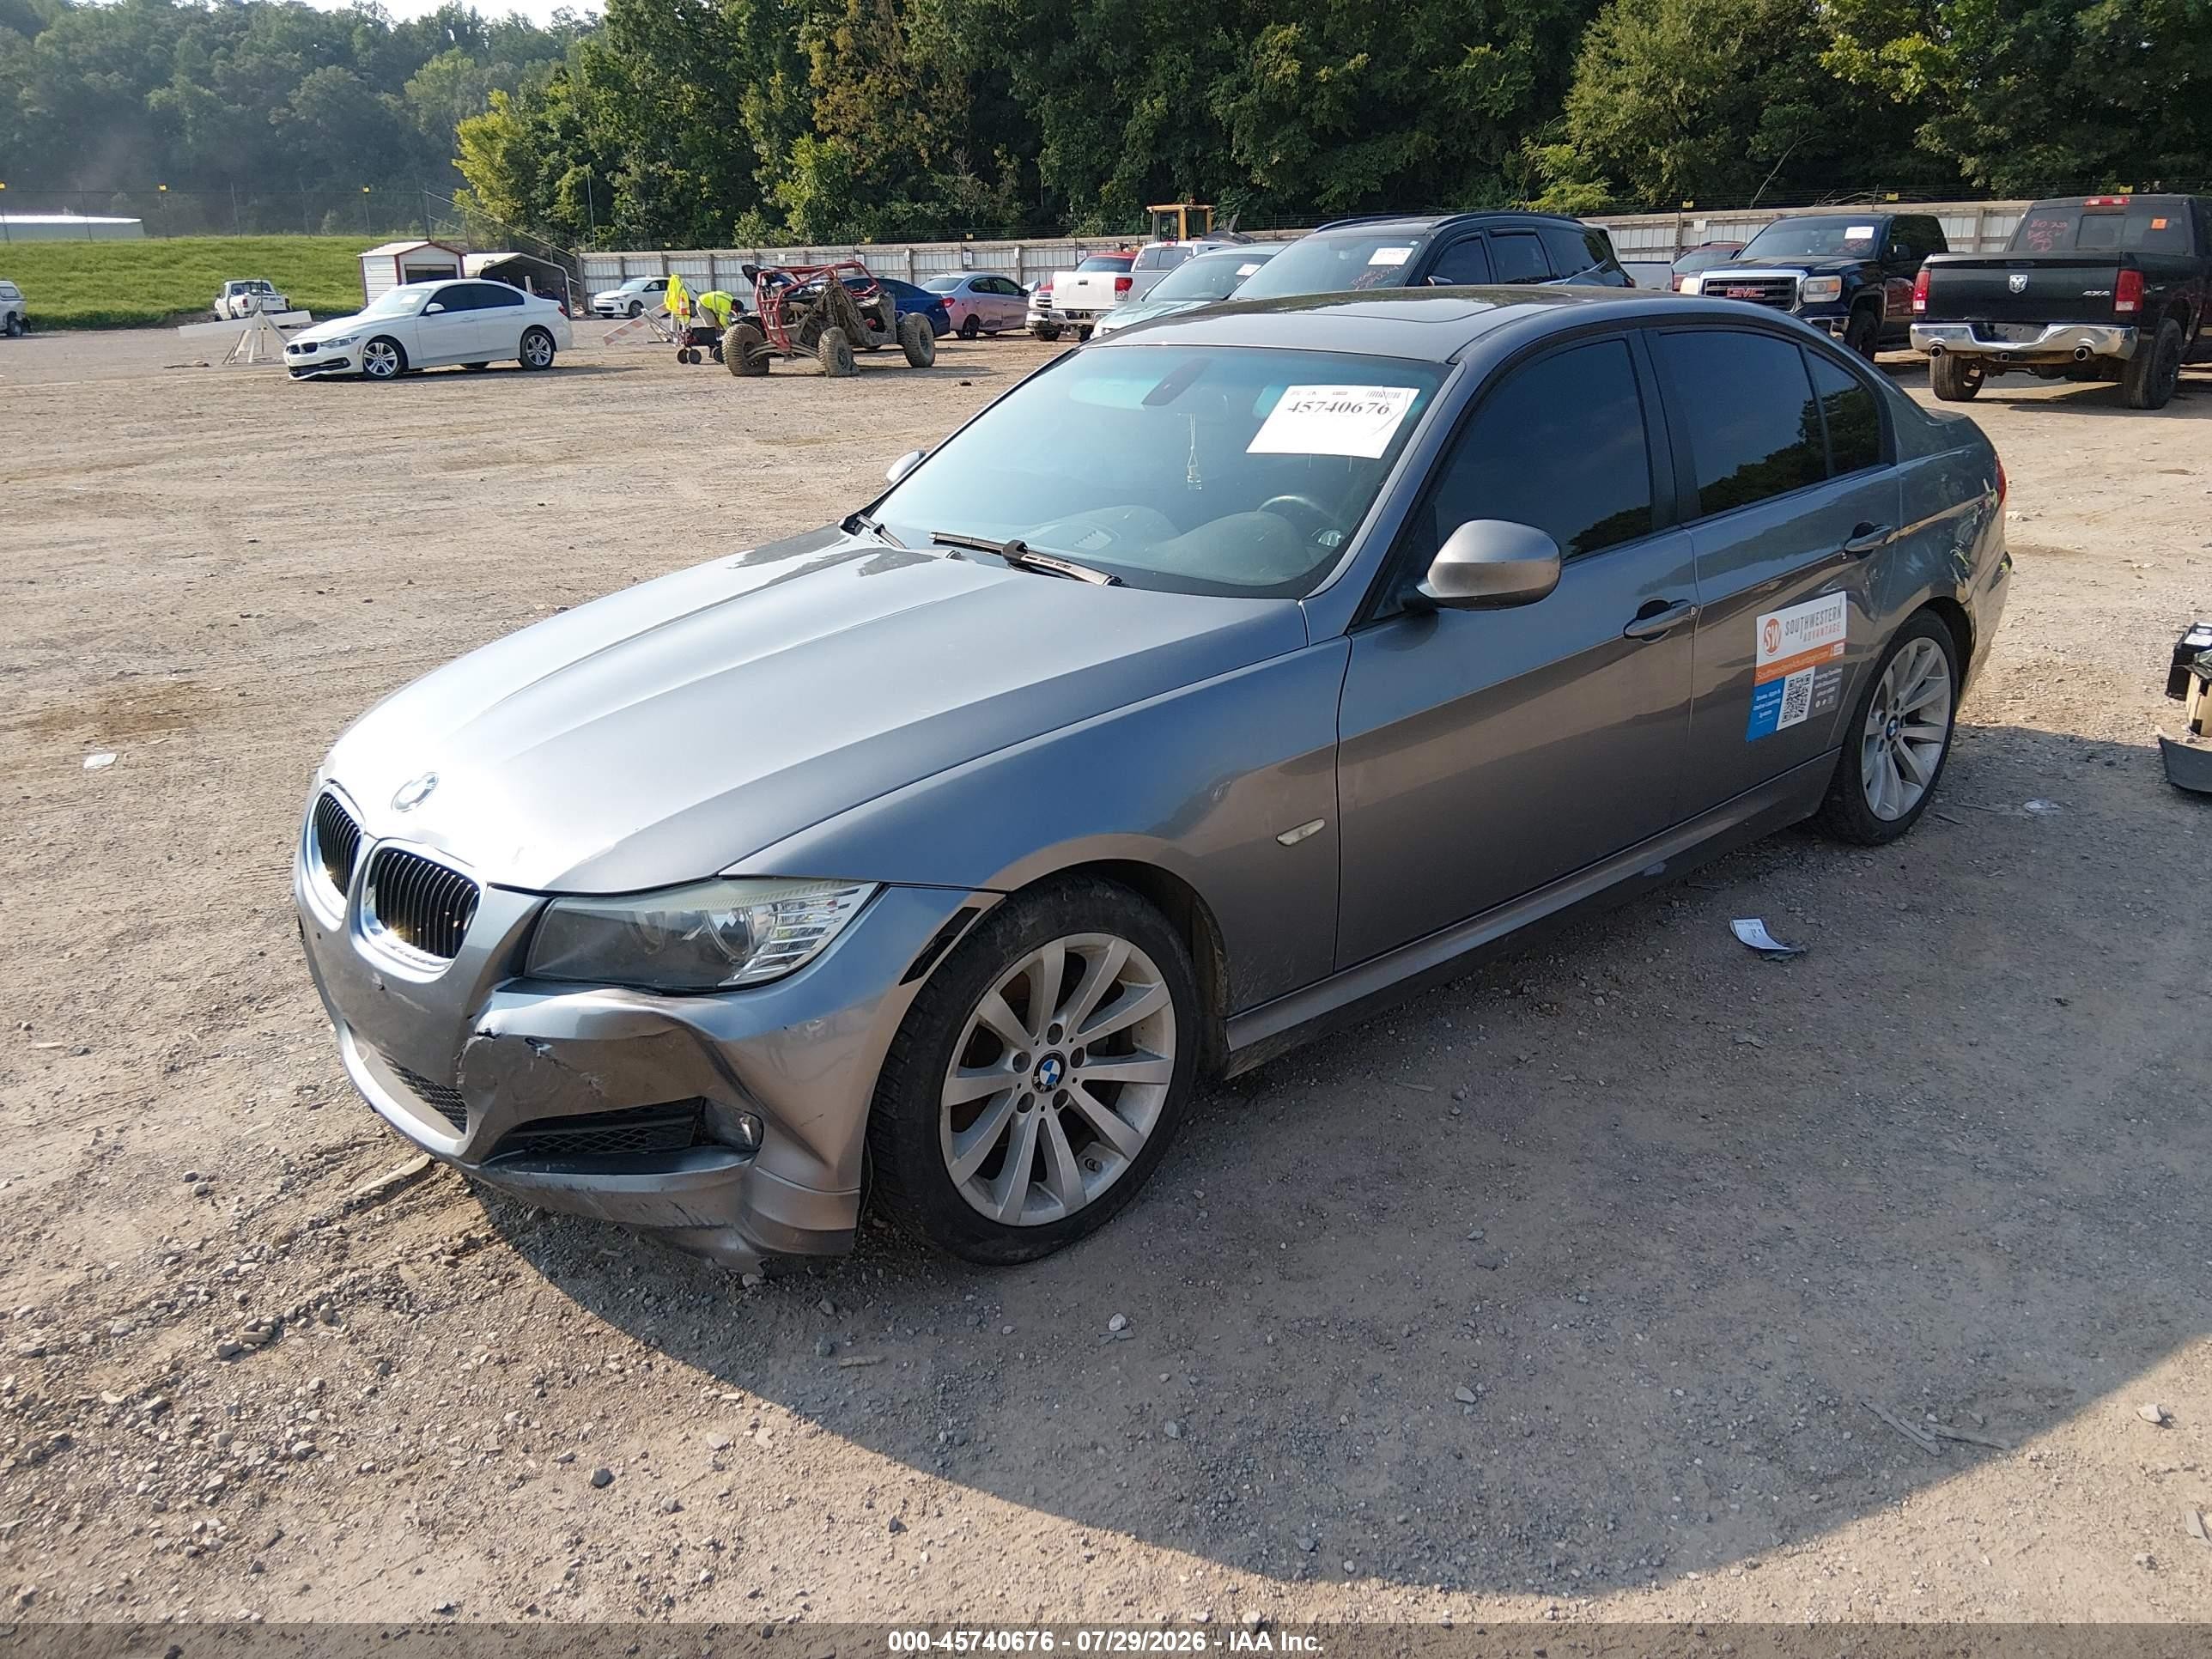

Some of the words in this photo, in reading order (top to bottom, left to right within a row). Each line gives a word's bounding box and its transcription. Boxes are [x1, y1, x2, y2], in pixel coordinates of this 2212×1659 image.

[1727, 288, 1765, 297] GMC
[1287, 400, 1392, 416] 45740676
[1784, 600, 1842, 639] SOUTHWESTERN
[1765, 624, 1781, 653] SW
